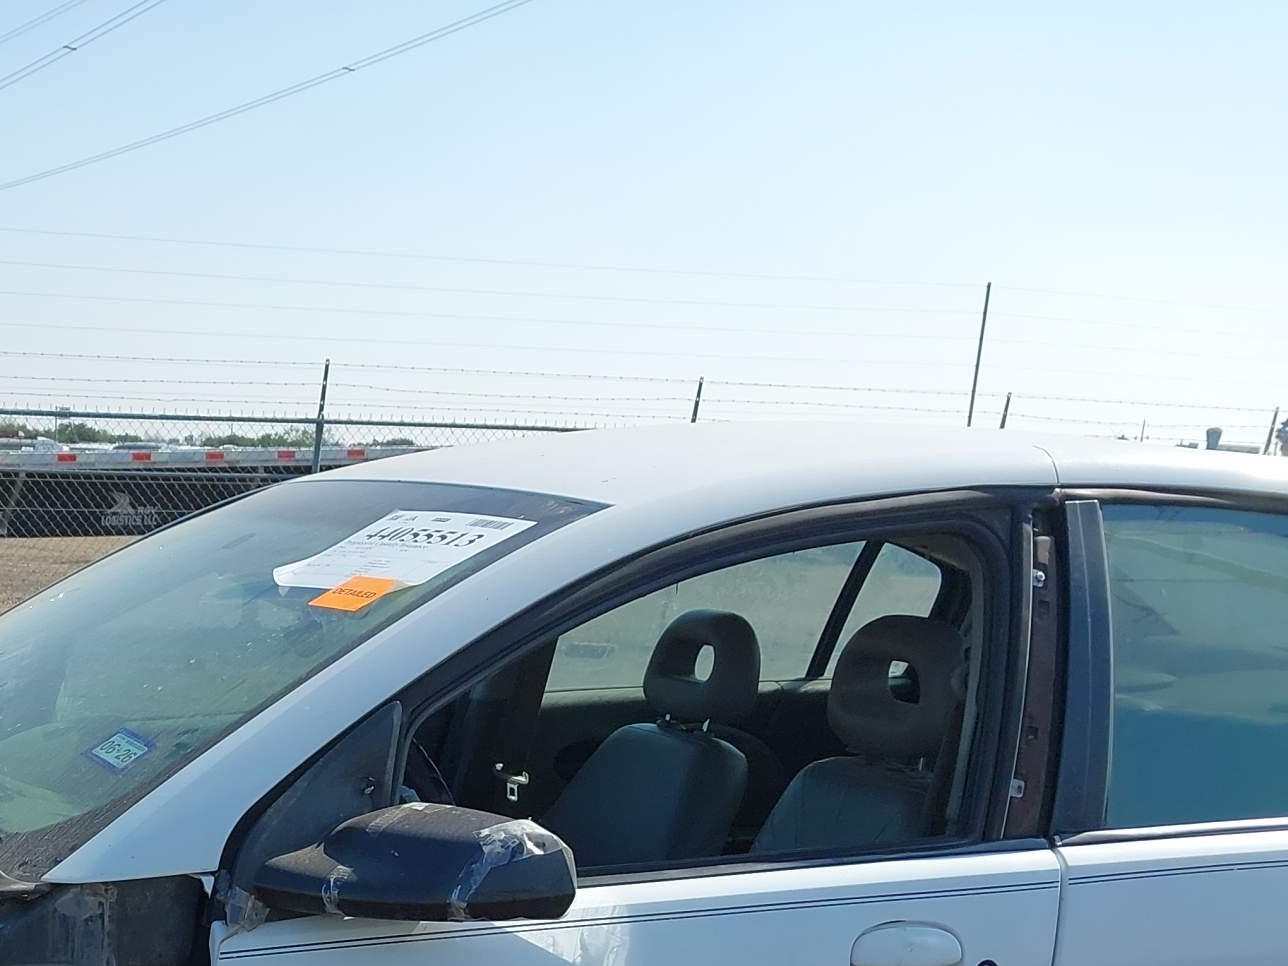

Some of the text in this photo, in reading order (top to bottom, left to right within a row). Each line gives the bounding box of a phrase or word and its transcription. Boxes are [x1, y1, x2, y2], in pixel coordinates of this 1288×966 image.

[101, 515, 142, 526] LOGISTICS
[366, 527, 485, 547] 44055513
[333, 587, 377, 599] DETAILED
